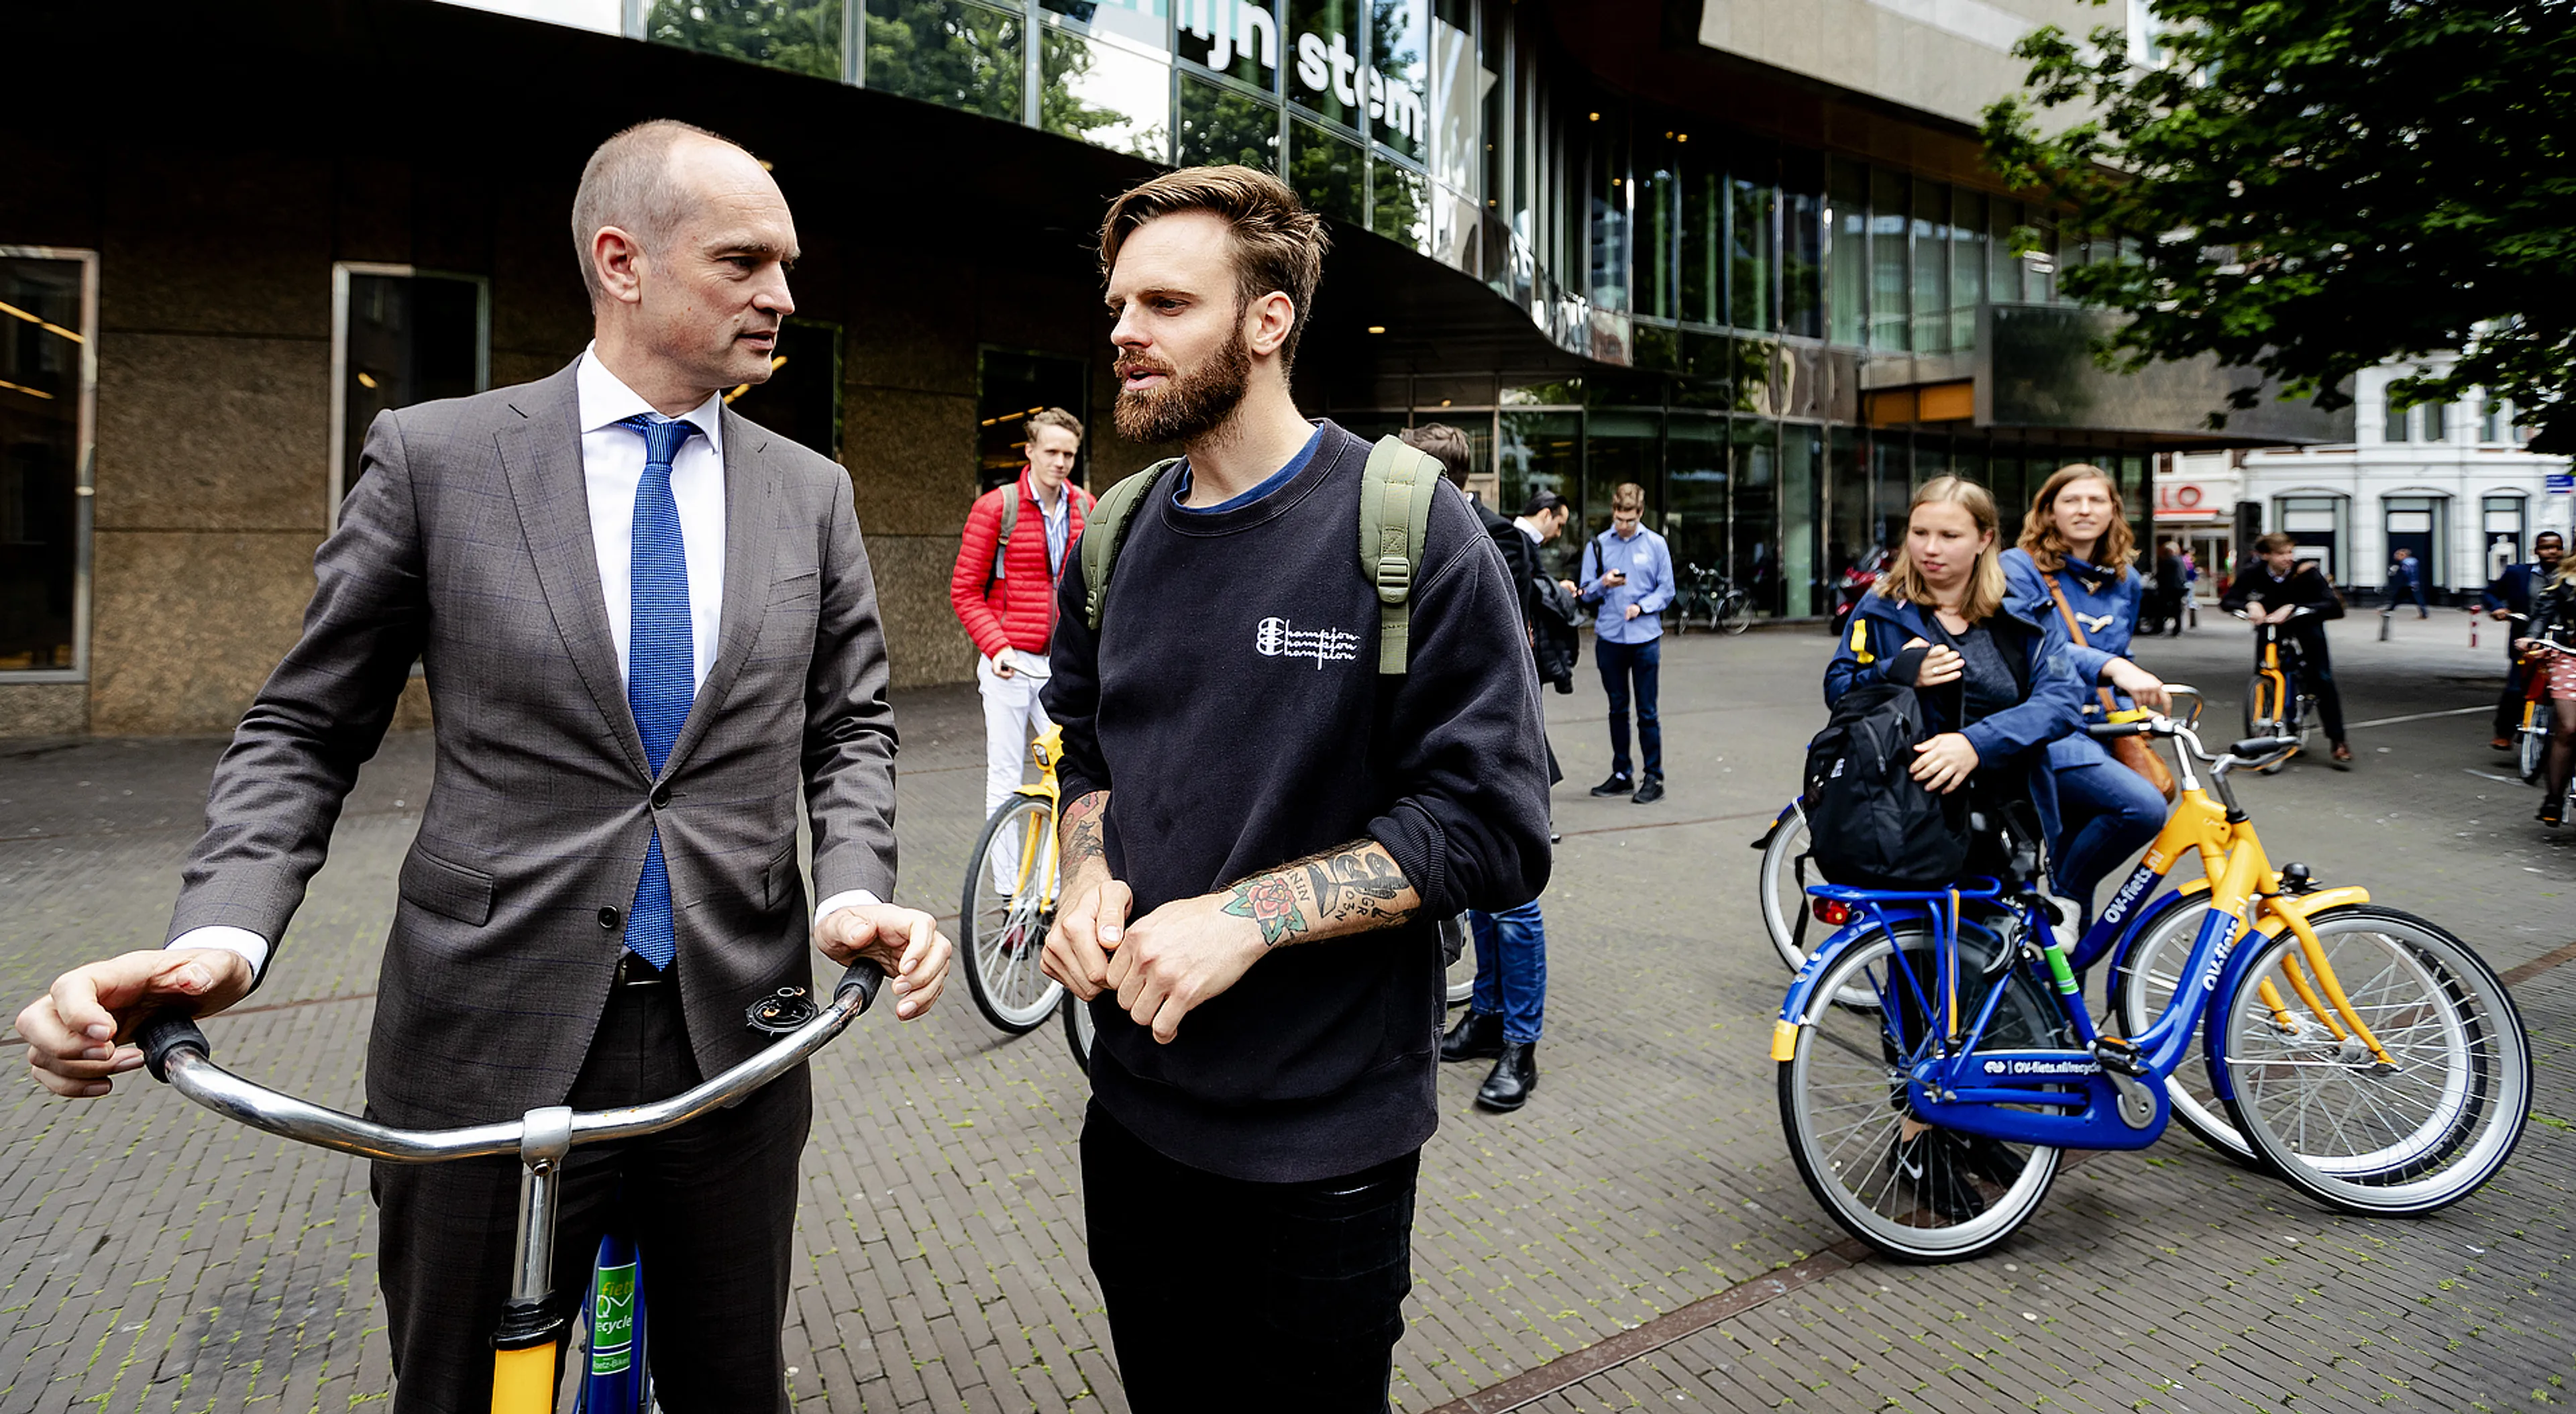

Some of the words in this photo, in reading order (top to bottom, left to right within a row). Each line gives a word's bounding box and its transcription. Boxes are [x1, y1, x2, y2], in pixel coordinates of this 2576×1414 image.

[1107, 0, 1277, 71] ijn
[1297, 32, 1424, 142] stem
[2104, 849, 2165, 924] OV-fiets.nl
[2202, 895, 2249, 991] OV-fietsnl
